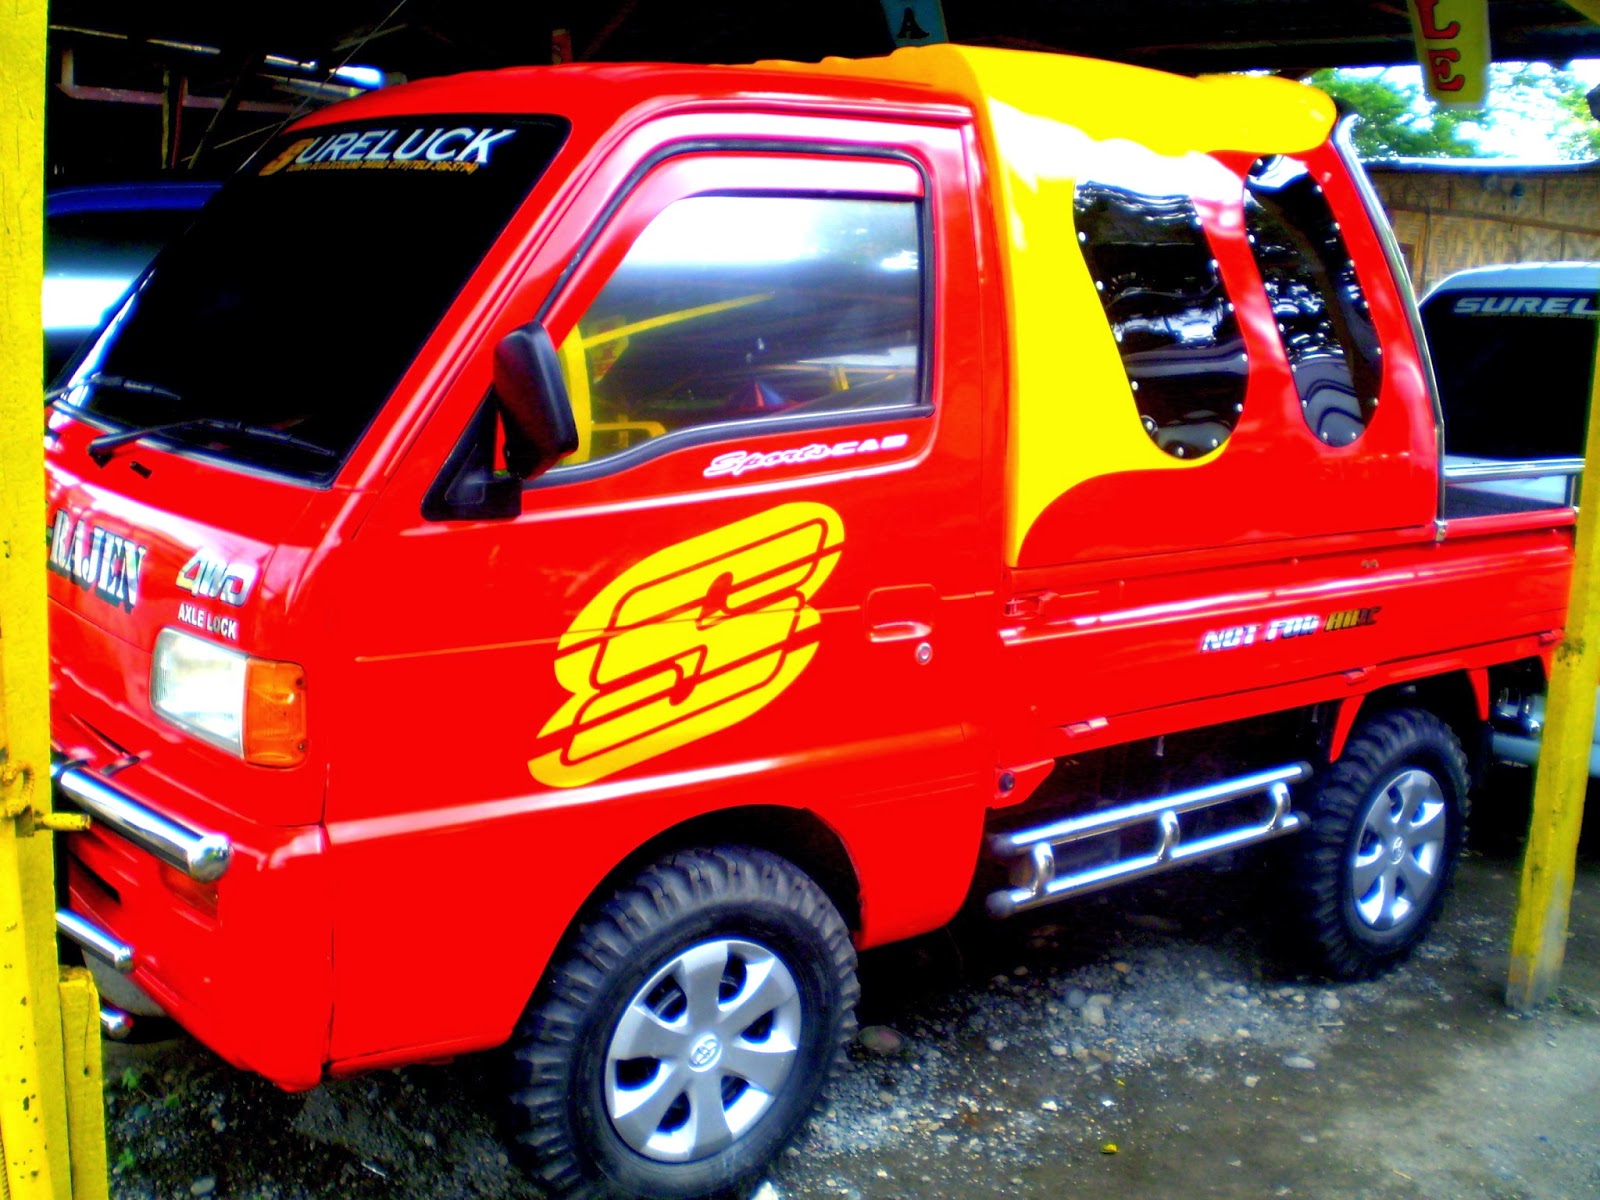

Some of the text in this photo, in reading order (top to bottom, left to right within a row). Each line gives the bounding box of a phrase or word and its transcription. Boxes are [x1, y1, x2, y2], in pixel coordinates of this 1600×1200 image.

[258, 127, 517, 176] SURELUCK
[175, 547, 259, 607] 4WD
[177, 603, 238, 640] AXLE LOCK
[1201, 624, 1261, 653] NOT
